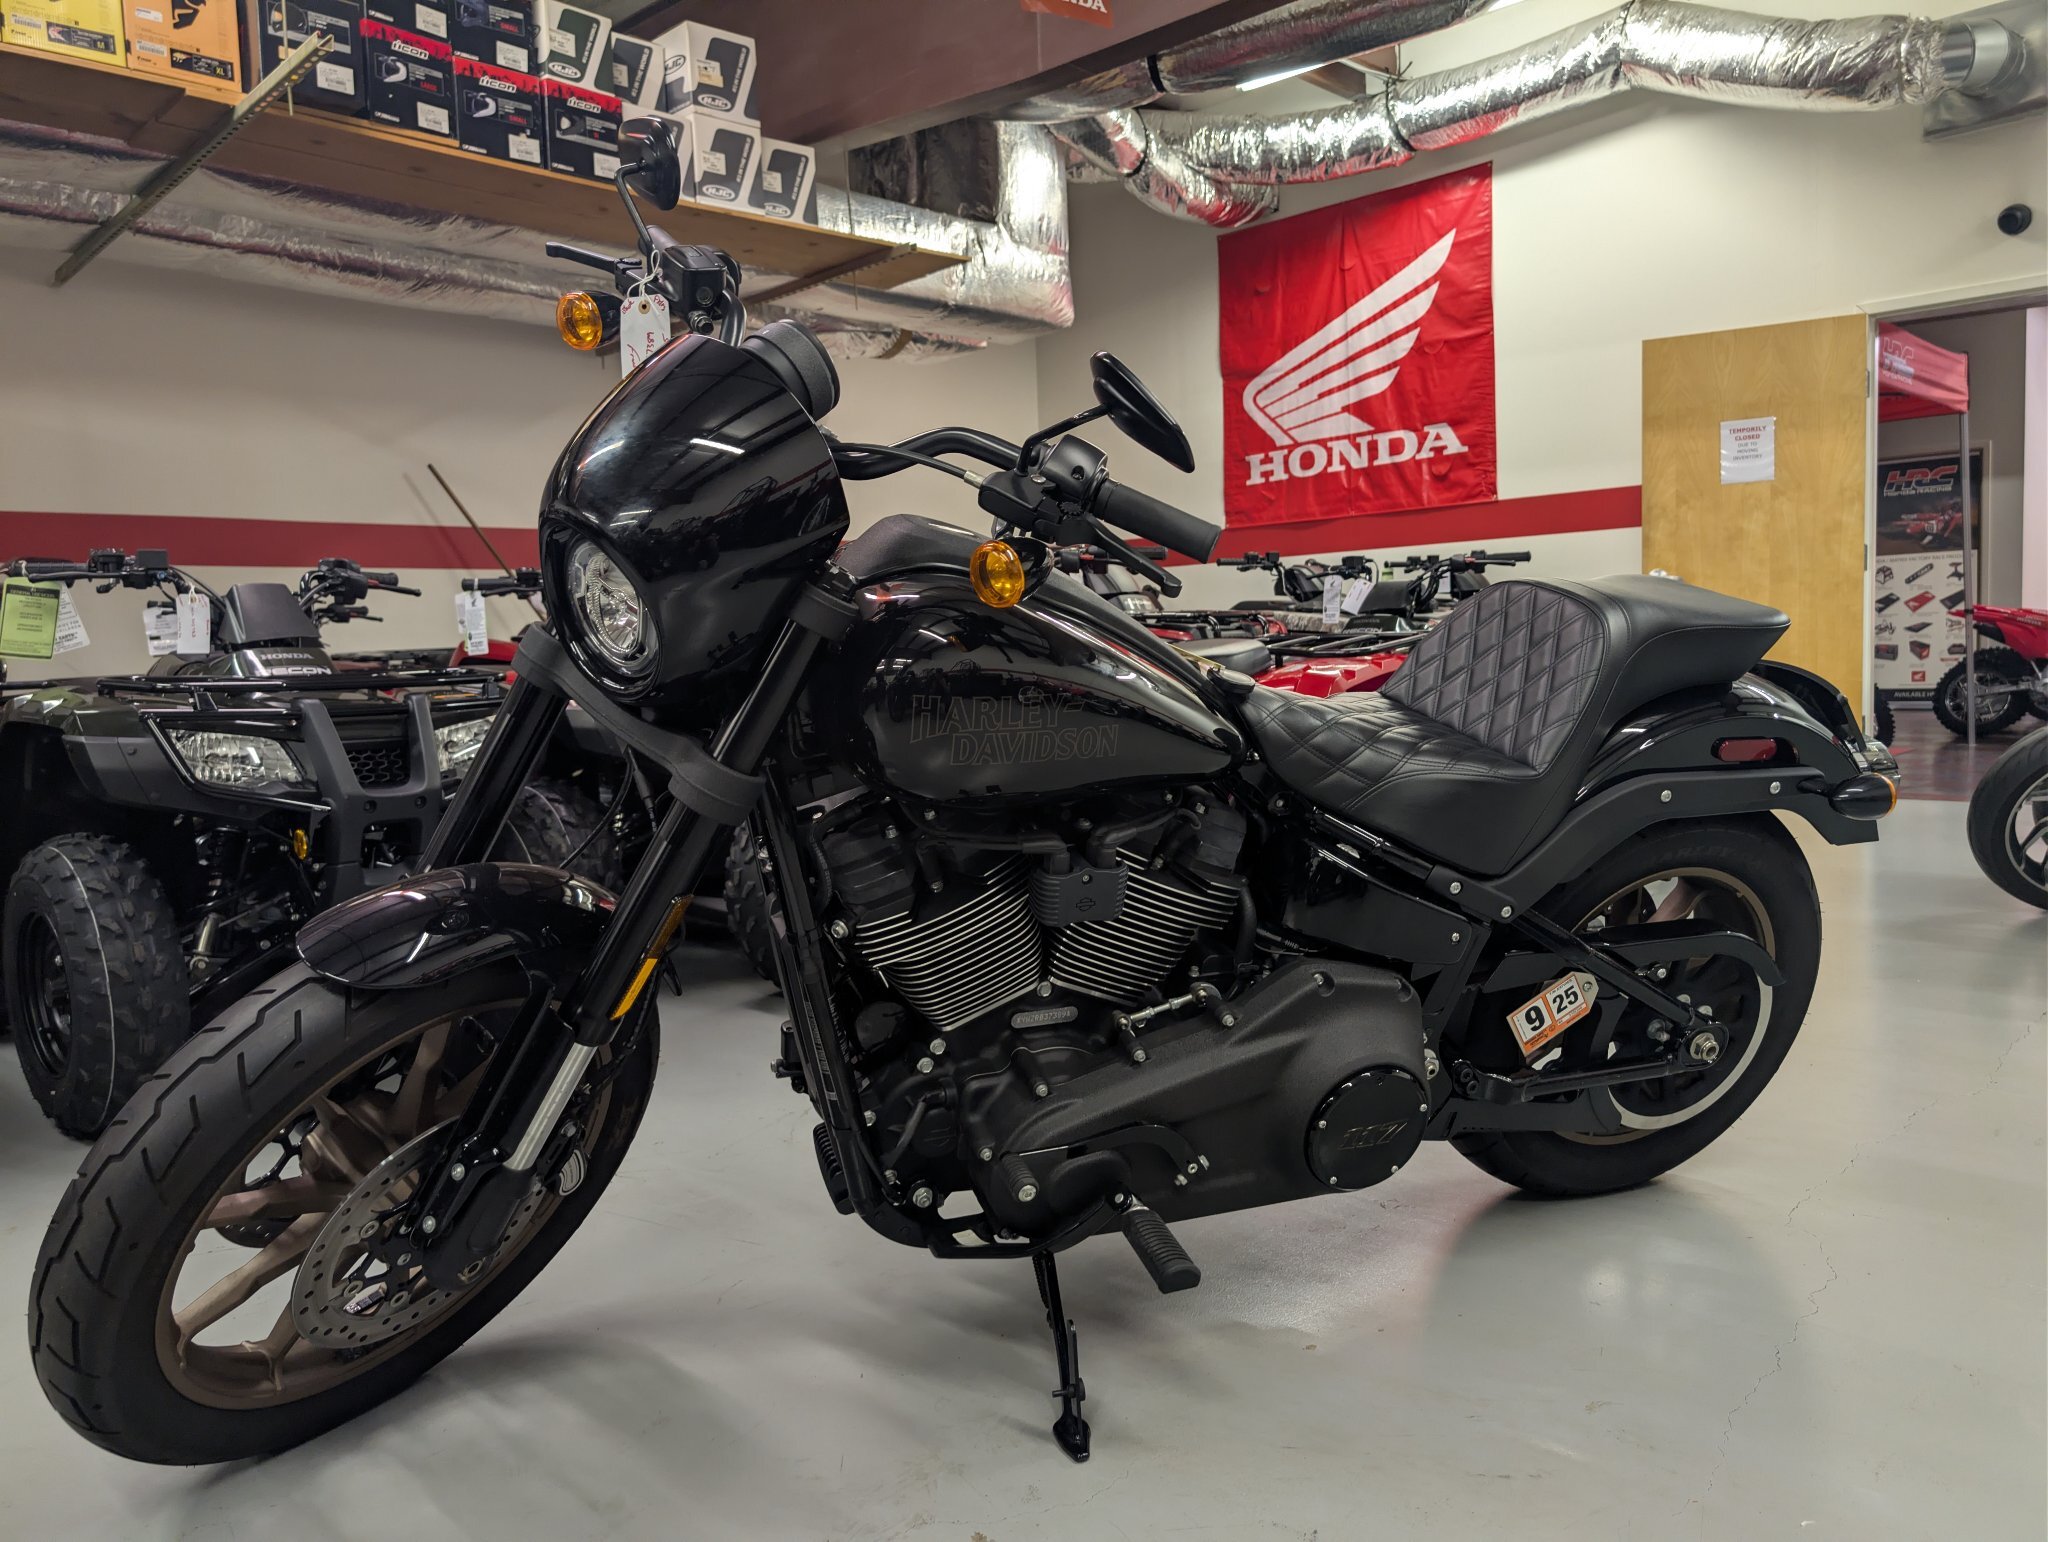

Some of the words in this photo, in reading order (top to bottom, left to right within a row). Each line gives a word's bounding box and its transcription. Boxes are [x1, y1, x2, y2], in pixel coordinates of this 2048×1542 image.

[215, 66, 225, 76] XL
[553, 64, 578, 77] HJC
[702, 96, 728, 108] HJC
[708, 186, 731, 199] HJC
[1729, 426, 1766, 434] TEMPORILY
[1245, 422, 1469, 487] HONDA
[1884, 464, 1959, 492] HRC
[950, 724, 1120, 766] DAVIDSON
[1524, 1004, 1546, 1033] 9
[1552, 985, 1580, 1016] 25
